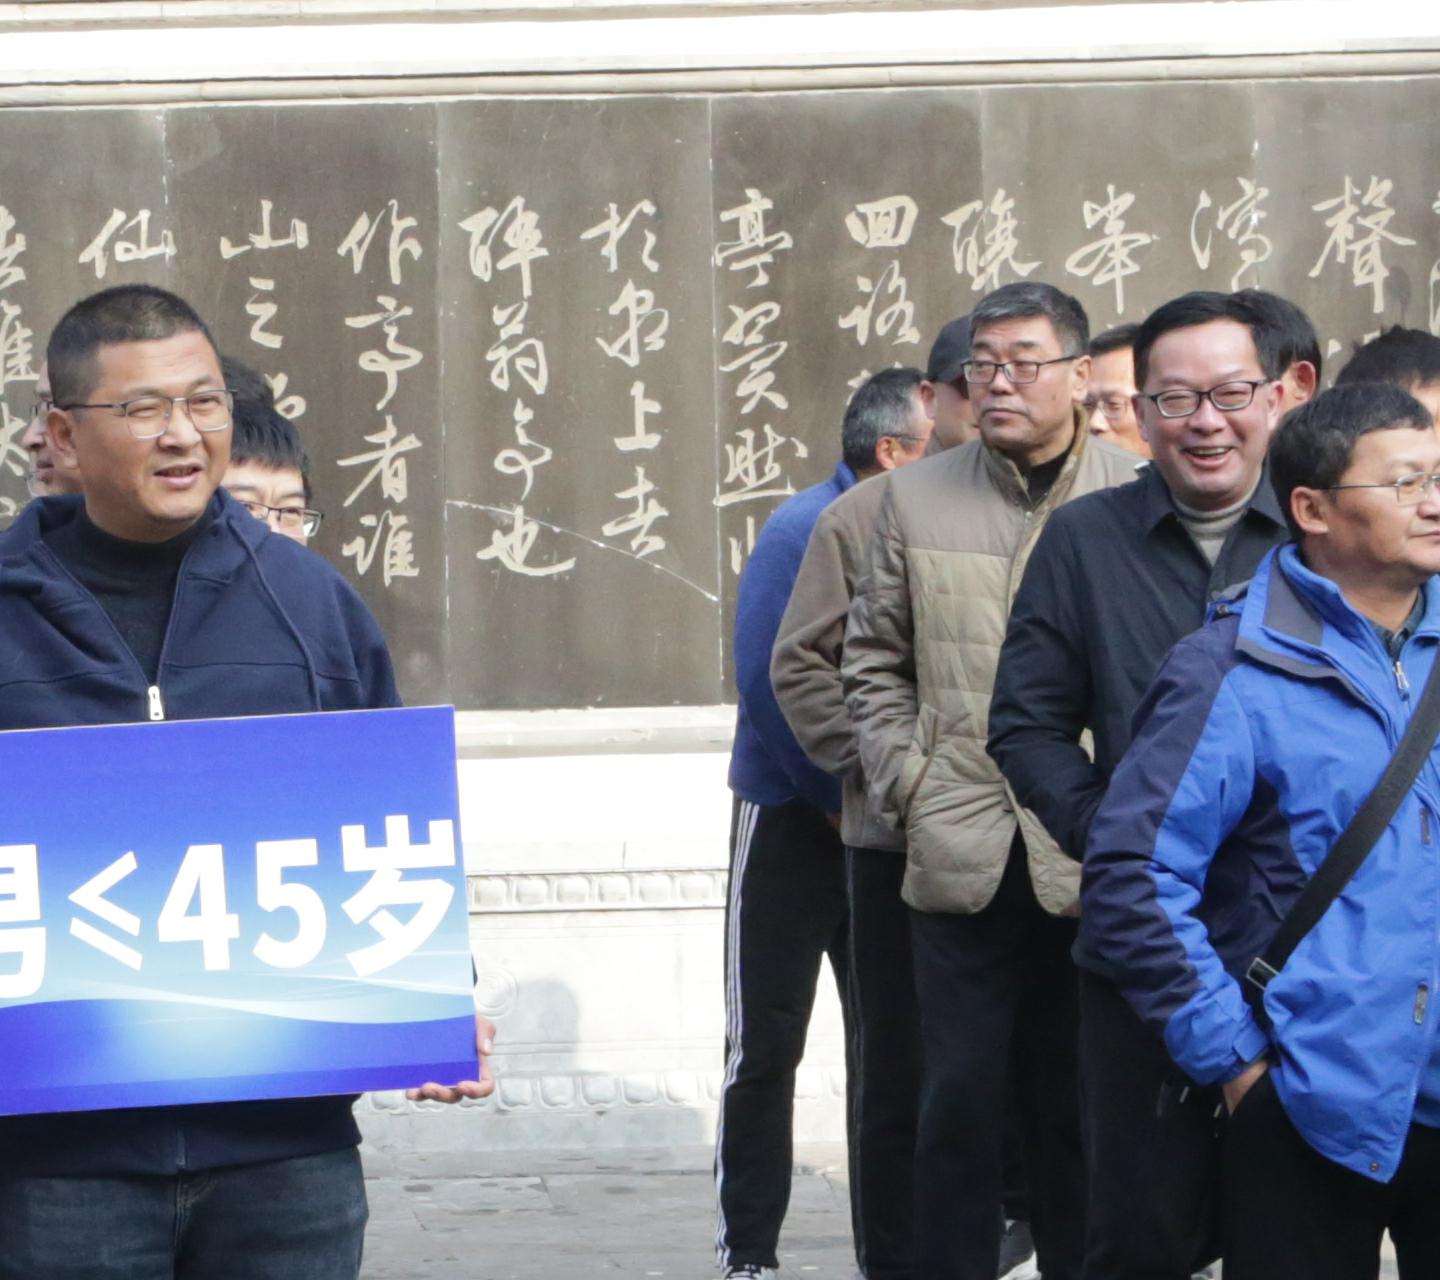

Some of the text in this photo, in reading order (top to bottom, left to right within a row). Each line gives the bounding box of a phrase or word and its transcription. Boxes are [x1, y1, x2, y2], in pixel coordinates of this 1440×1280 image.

[839, 195, 922, 406] 回路
[1308, 175, 1417, 360] 聲
[713, 188, 808, 575] 亭翼然
